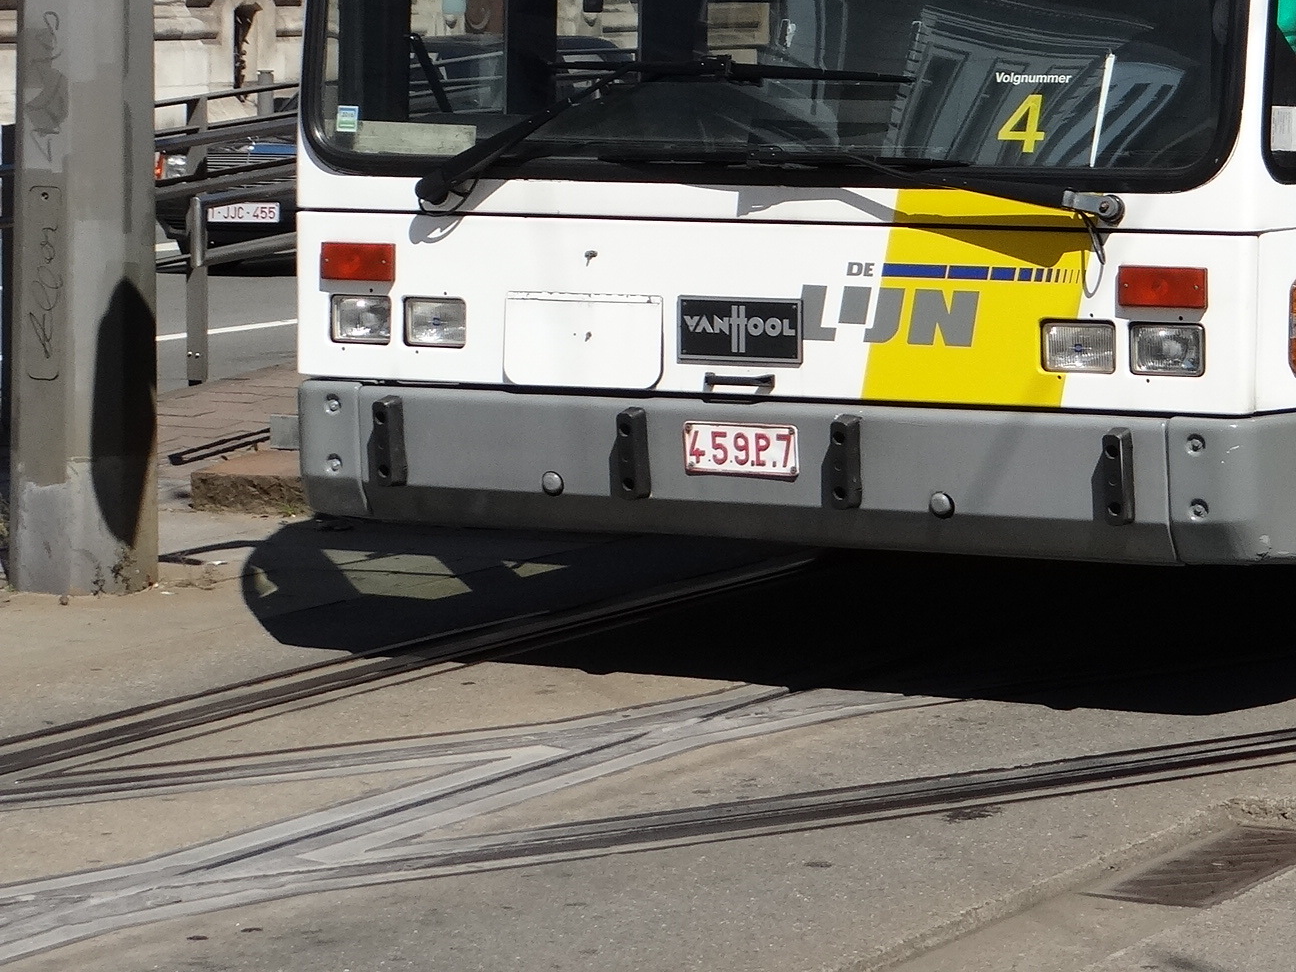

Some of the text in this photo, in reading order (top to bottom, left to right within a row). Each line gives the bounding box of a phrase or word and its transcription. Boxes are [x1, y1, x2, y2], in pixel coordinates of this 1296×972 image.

[995, 71, 1073, 86] Volgnummer
[997, 94, 1045, 153] 4
[846, 261, 875, 277] DE
[801, 284, 980, 348] LIJN
